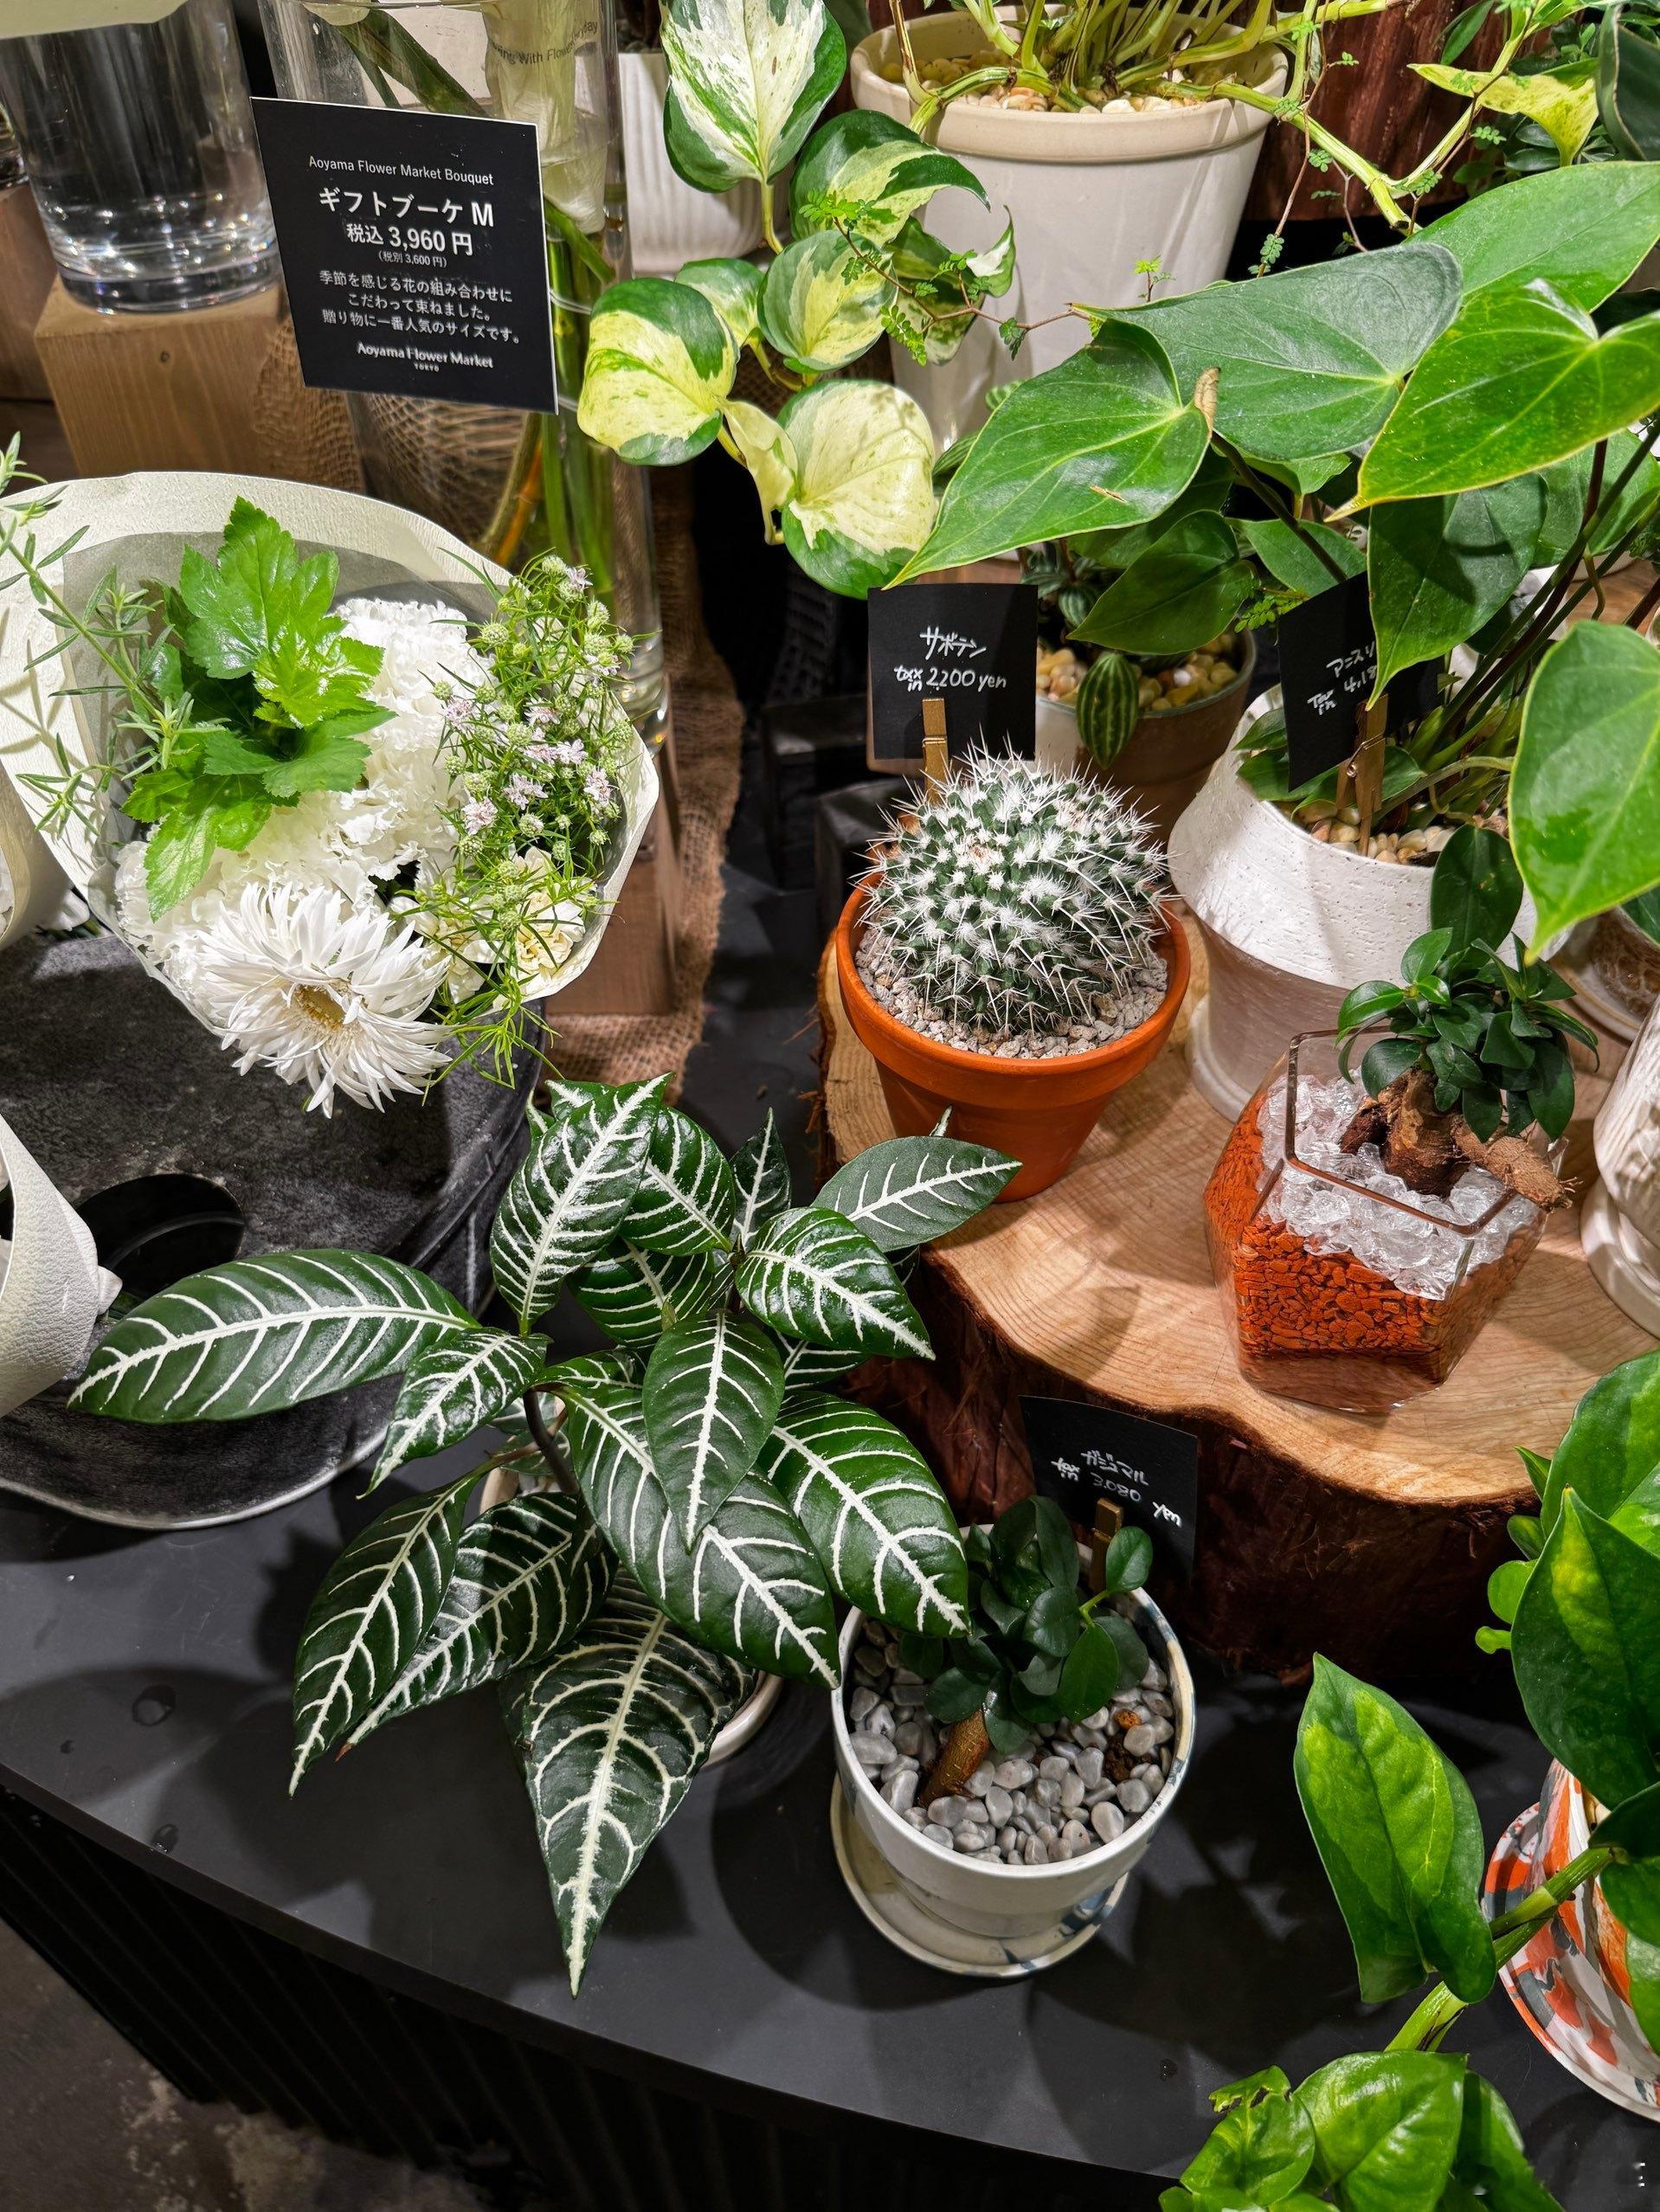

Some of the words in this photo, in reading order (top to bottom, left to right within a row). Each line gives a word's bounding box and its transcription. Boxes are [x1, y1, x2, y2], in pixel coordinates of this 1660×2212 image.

[519, 52, 543, 64] With
[309, 156, 355, 171] Aoyama
[357, 160, 396, 175] Flower
[400, 164, 442, 180] Market
[445, 168, 494, 185] Bouquet
[318, 187, 463, 224] ギフトブーケ
[471, 201, 494, 228] M
[346, 223, 384, 245] 税込
[388, 226, 446, 252] 3,960
[451, 231, 473, 256] 円
[318, 270, 512, 302] 季節を感じる花の組み合わせに
[348, 293, 491, 322] こだわって束ねました。
[322, 309, 519, 344] 贈り物に一番人気のサイズです。
[357, 341, 405, 358] Aoyama
[405, 346, 448, 363] Flower
[449, 350, 494, 369] Market
[919, 626, 987, 660] サボテン
[978, 674, 1007, 692] yen
